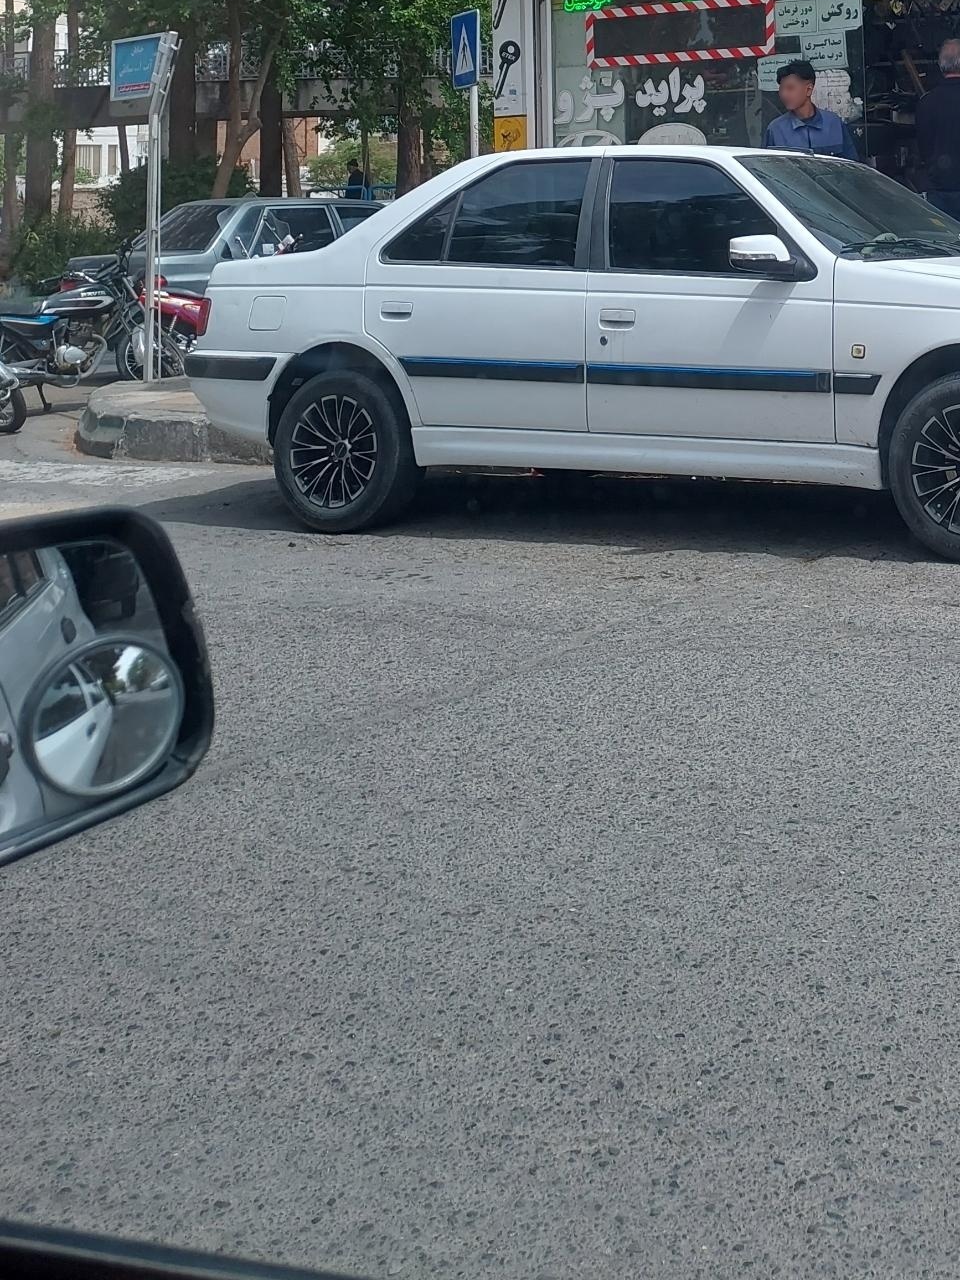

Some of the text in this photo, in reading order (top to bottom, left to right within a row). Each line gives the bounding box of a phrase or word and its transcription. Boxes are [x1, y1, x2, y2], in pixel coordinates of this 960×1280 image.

[778, 4, 813, 17] دور فرمان
[821, 2, 859, 23] روکش
[553, 66, 708, 125] پراید پژو
